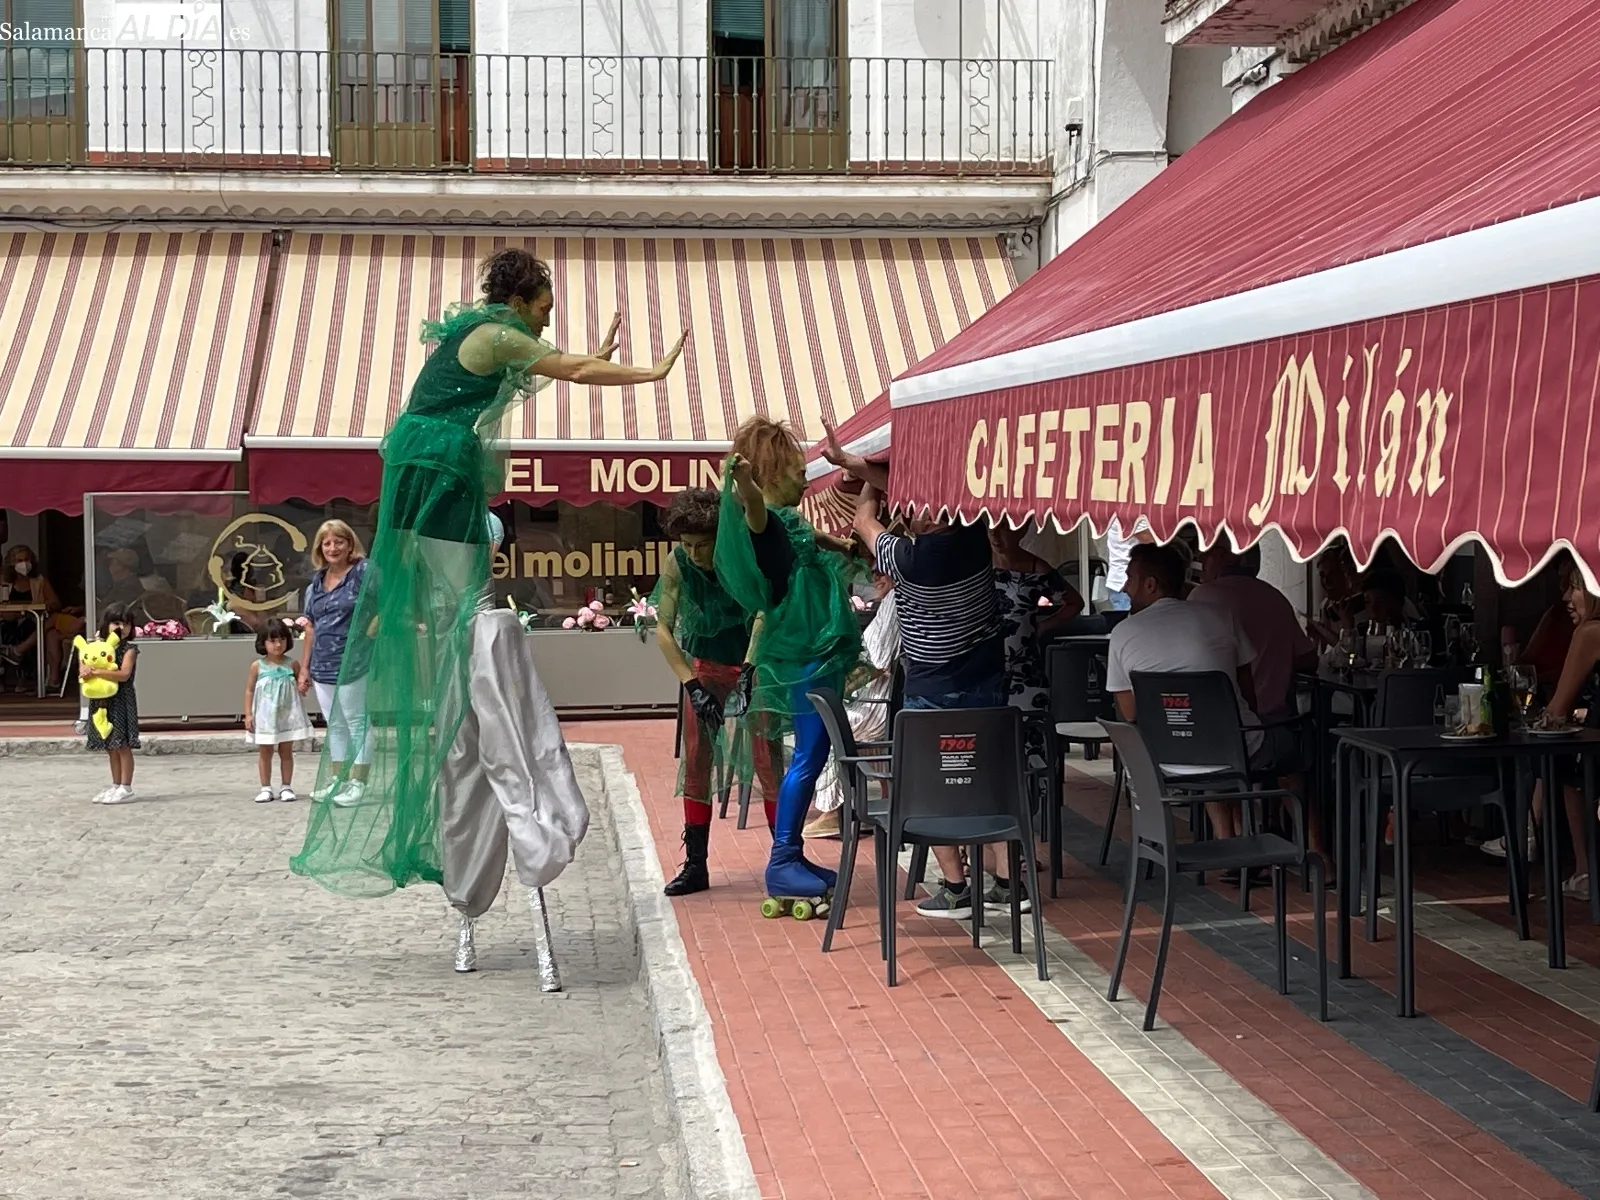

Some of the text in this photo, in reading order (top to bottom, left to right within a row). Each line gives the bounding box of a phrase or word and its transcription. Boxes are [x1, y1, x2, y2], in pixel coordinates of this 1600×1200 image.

[966, 342, 1454, 526] CAFETERIA Milán
[504, 458, 559, 492] EL
[491, 542, 517, 579] el
[939, 738, 976, 751] 1906
